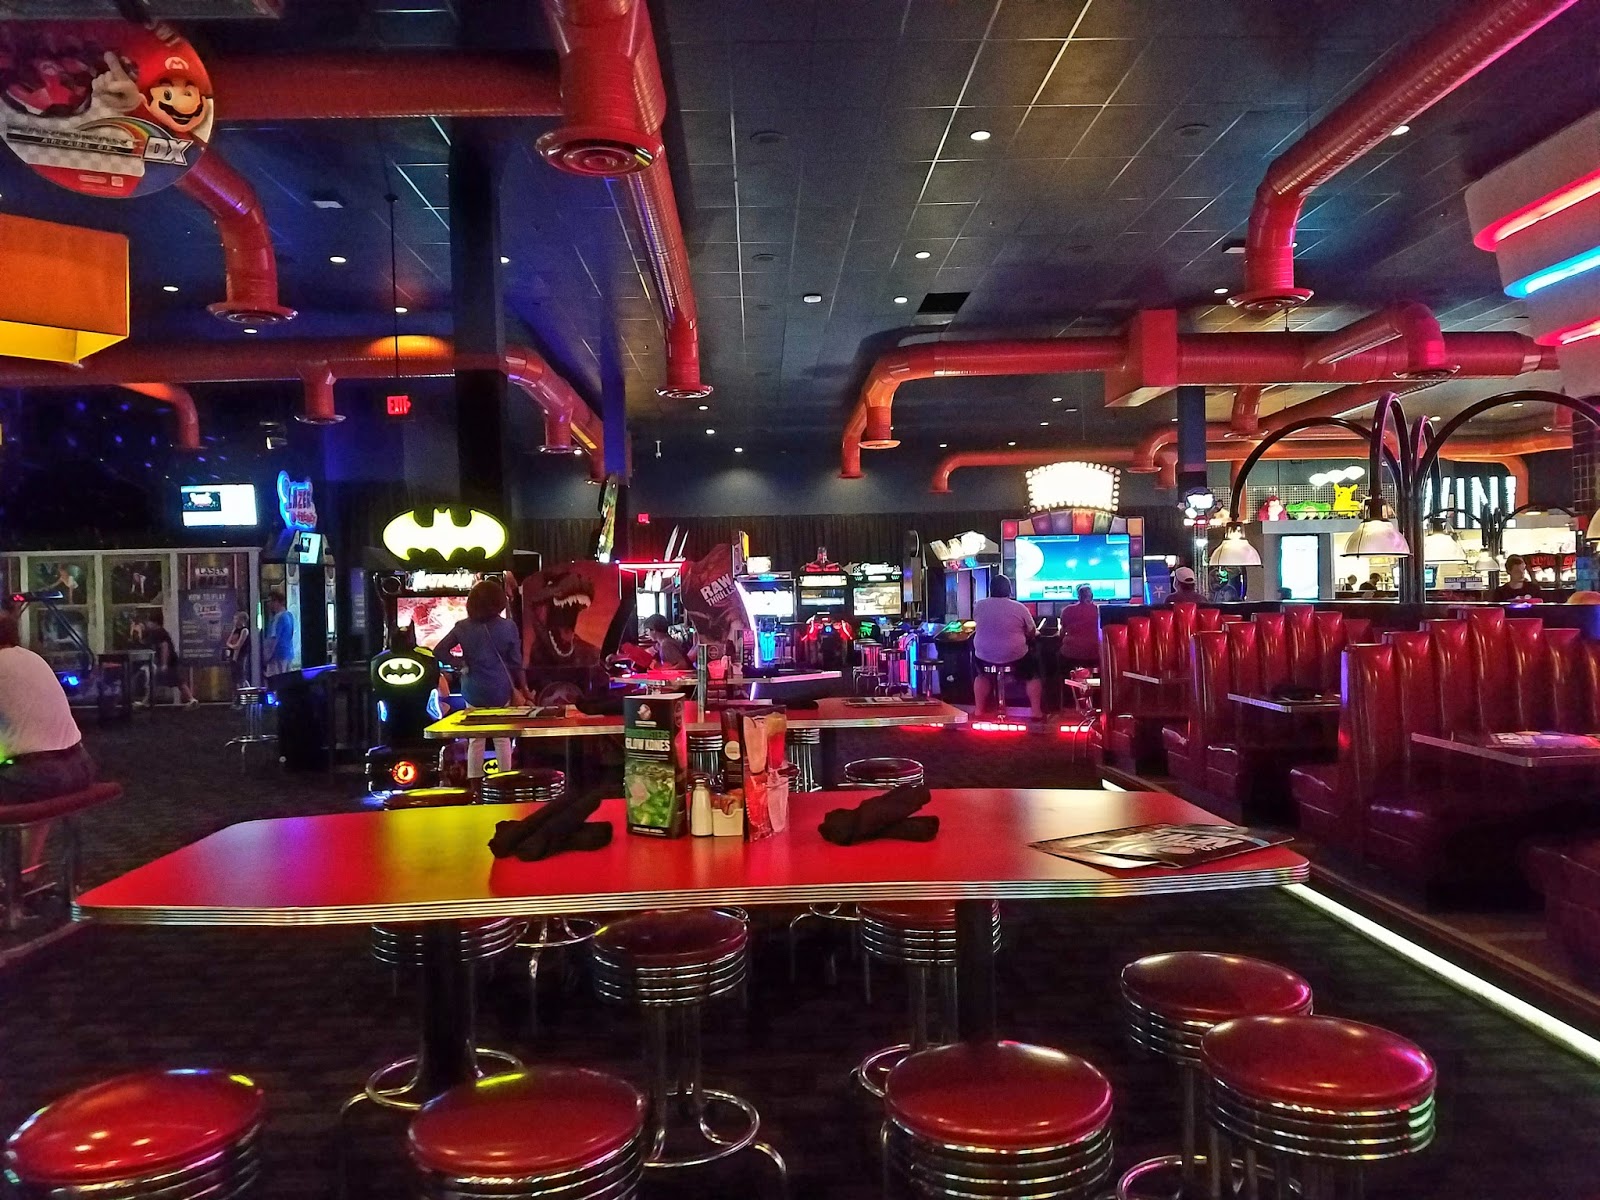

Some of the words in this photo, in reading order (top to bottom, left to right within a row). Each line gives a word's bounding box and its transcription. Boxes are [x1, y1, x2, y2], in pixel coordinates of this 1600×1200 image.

[143, 136, 193, 166] DX
[387, 396, 409, 414] EXIT
[700, 573, 731, 600] RAW
[705, 586, 737, 607] THRILLS
